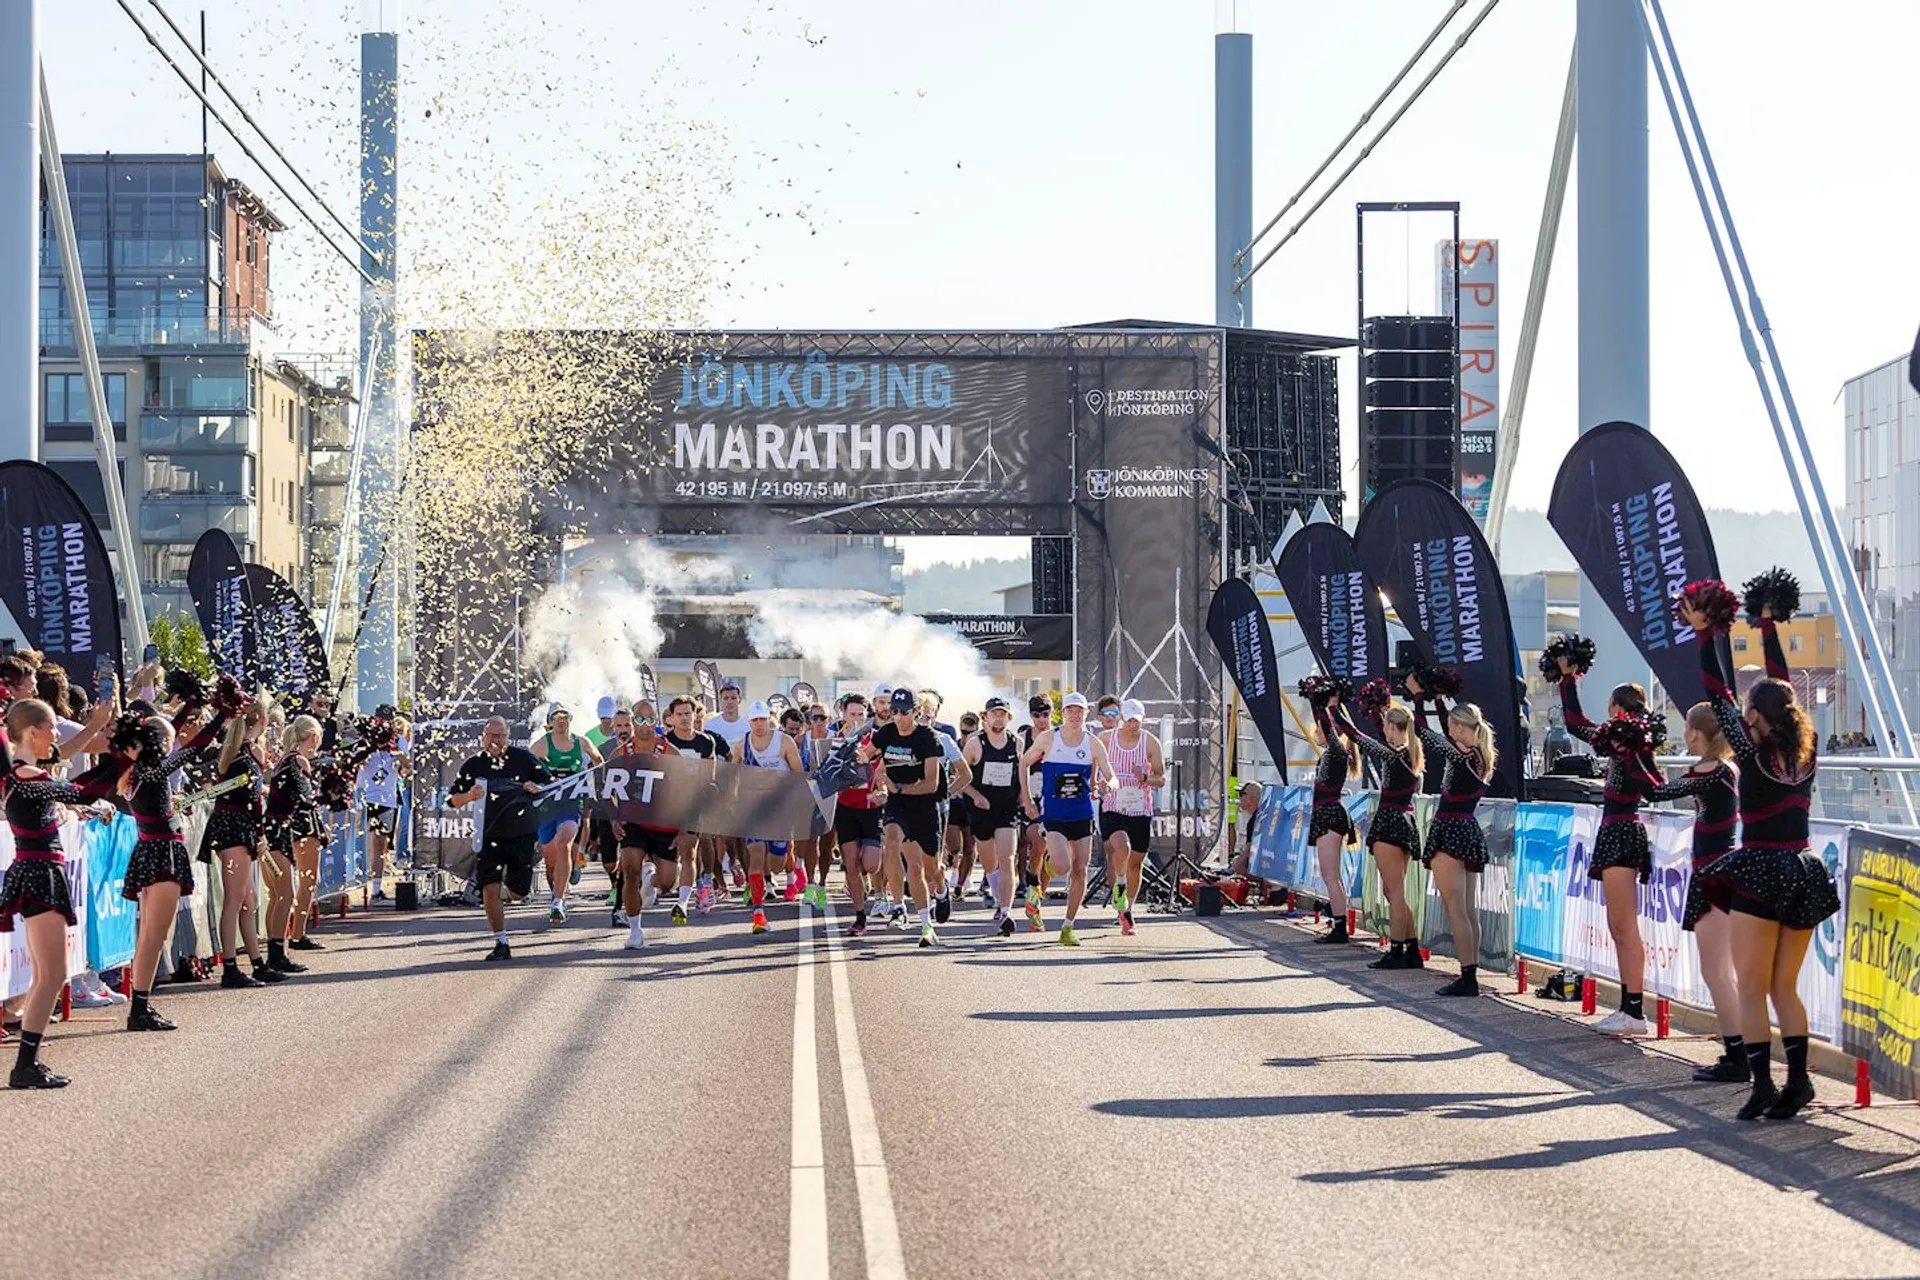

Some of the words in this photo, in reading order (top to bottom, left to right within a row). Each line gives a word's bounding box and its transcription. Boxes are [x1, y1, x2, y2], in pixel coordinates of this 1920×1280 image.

[1460, 240, 1495, 423] SPIRA
[677, 354, 956, 408] JÖNKÖPING
[1117, 389, 1209, 401] DESTINATION
[1117, 402, 1195, 416] JÖNKÖPING
[675, 423, 951, 470] MARATHON
[733, 482, 747, 496] M
[833, 482, 847, 496] M
[1115, 465, 1209, 482] JÖNKÖPINGS
[1115, 485, 1193, 498] KOMMUN
[37, 525, 66, 654] JÖNKÖPING
[62, 521, 92, 653] MARATHON
[1427, 538, 1458, 664] JÖNKÖPING
[1452, 535, 1483, 662] MARATHON
[1626, 493, 1670, 650] JÖNKÖPING
[952, 621, 1016, 633] MARATHON
[1247, 609, 1267, 697] MARATHON
[1330, 573, 1348, 677] JÖNKÖPING
[1348, 571, 1368, 677] MARATHON
